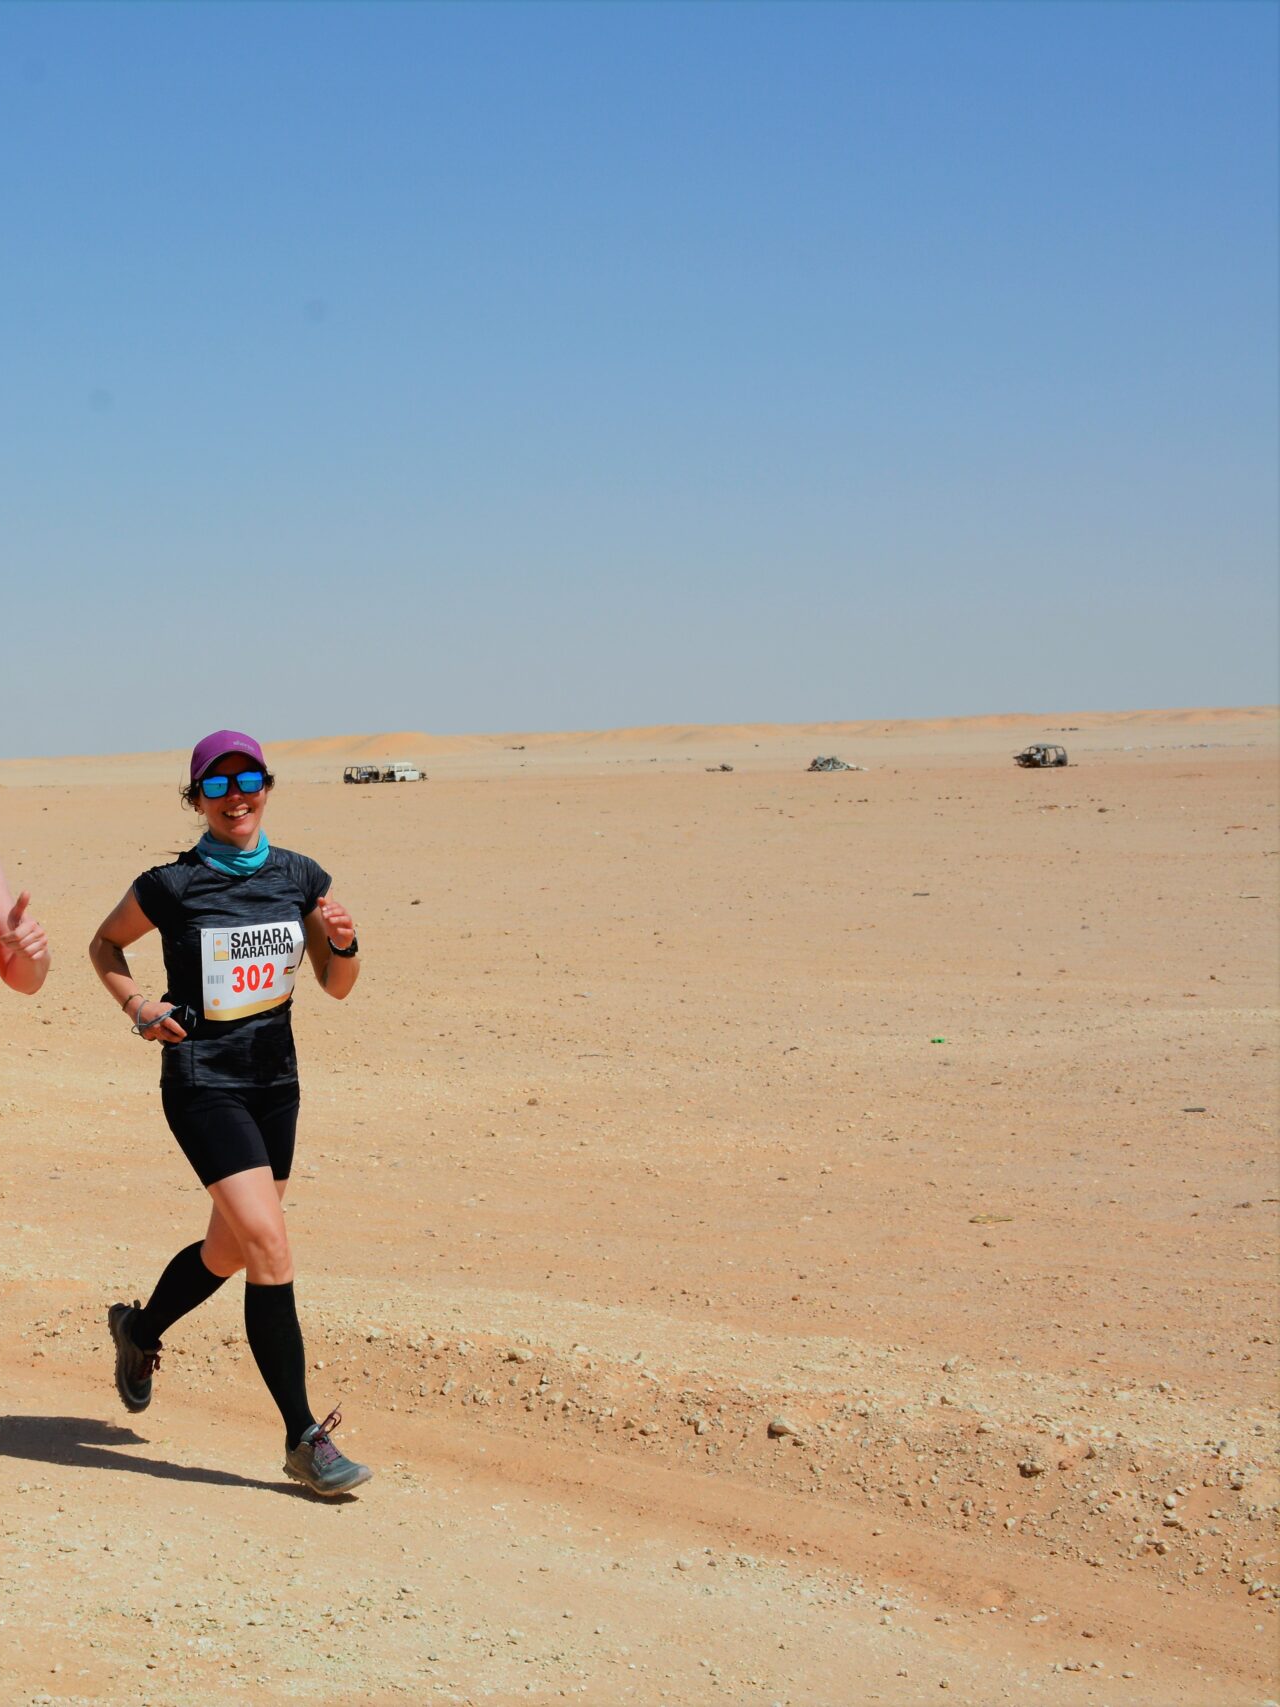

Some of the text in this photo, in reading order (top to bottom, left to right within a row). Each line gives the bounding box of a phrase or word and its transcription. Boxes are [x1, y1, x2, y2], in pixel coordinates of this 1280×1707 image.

[231, 927, 293, 948] SAHARA
[231, 942, 294, 960] MARATHON
[232, 963, 275, 993] 302
